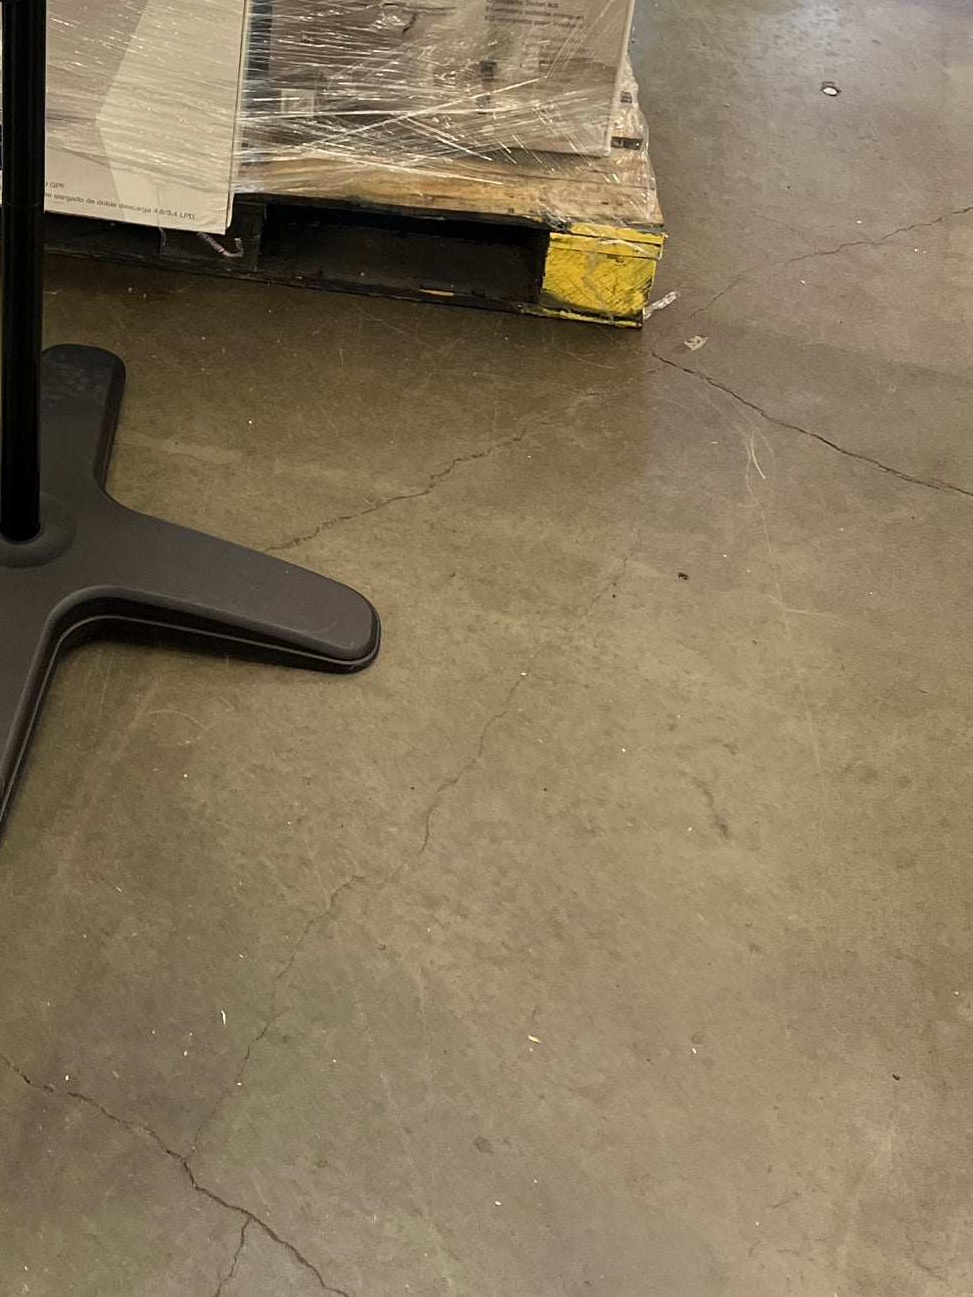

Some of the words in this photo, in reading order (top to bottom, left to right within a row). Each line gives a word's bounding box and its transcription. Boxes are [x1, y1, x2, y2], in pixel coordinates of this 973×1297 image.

[49, 181, 66, 190] GPF
[53, 193, 85, 204] alargado
[85, 196, 96, 205] de
[96, 198, 117, 208] doble
[118, 202, 152, 214] descarga
[179, 211, 195, 220] LPD
